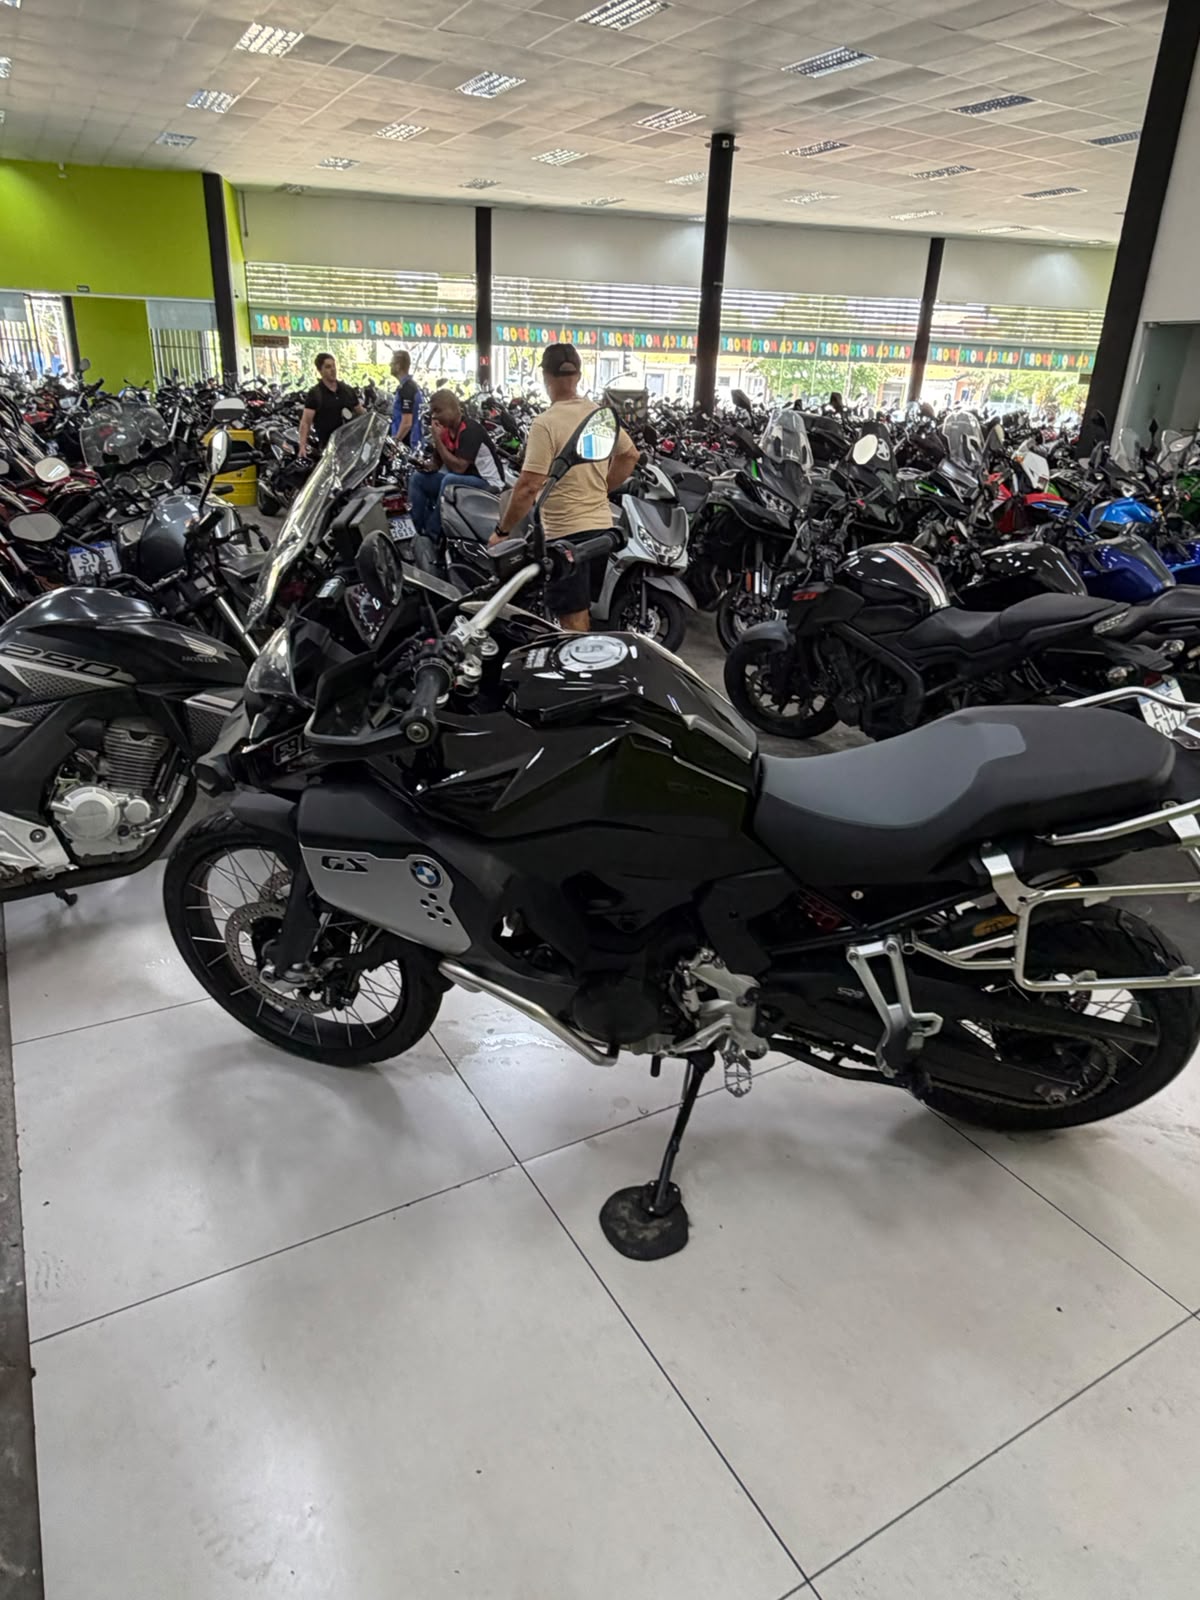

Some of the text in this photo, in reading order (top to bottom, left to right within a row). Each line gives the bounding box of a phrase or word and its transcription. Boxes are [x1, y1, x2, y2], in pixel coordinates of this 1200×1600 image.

[0, 642, 120, 678] 250
[181, 655, 219, 664] HONDA
[321, 855, 369, 873] GS
